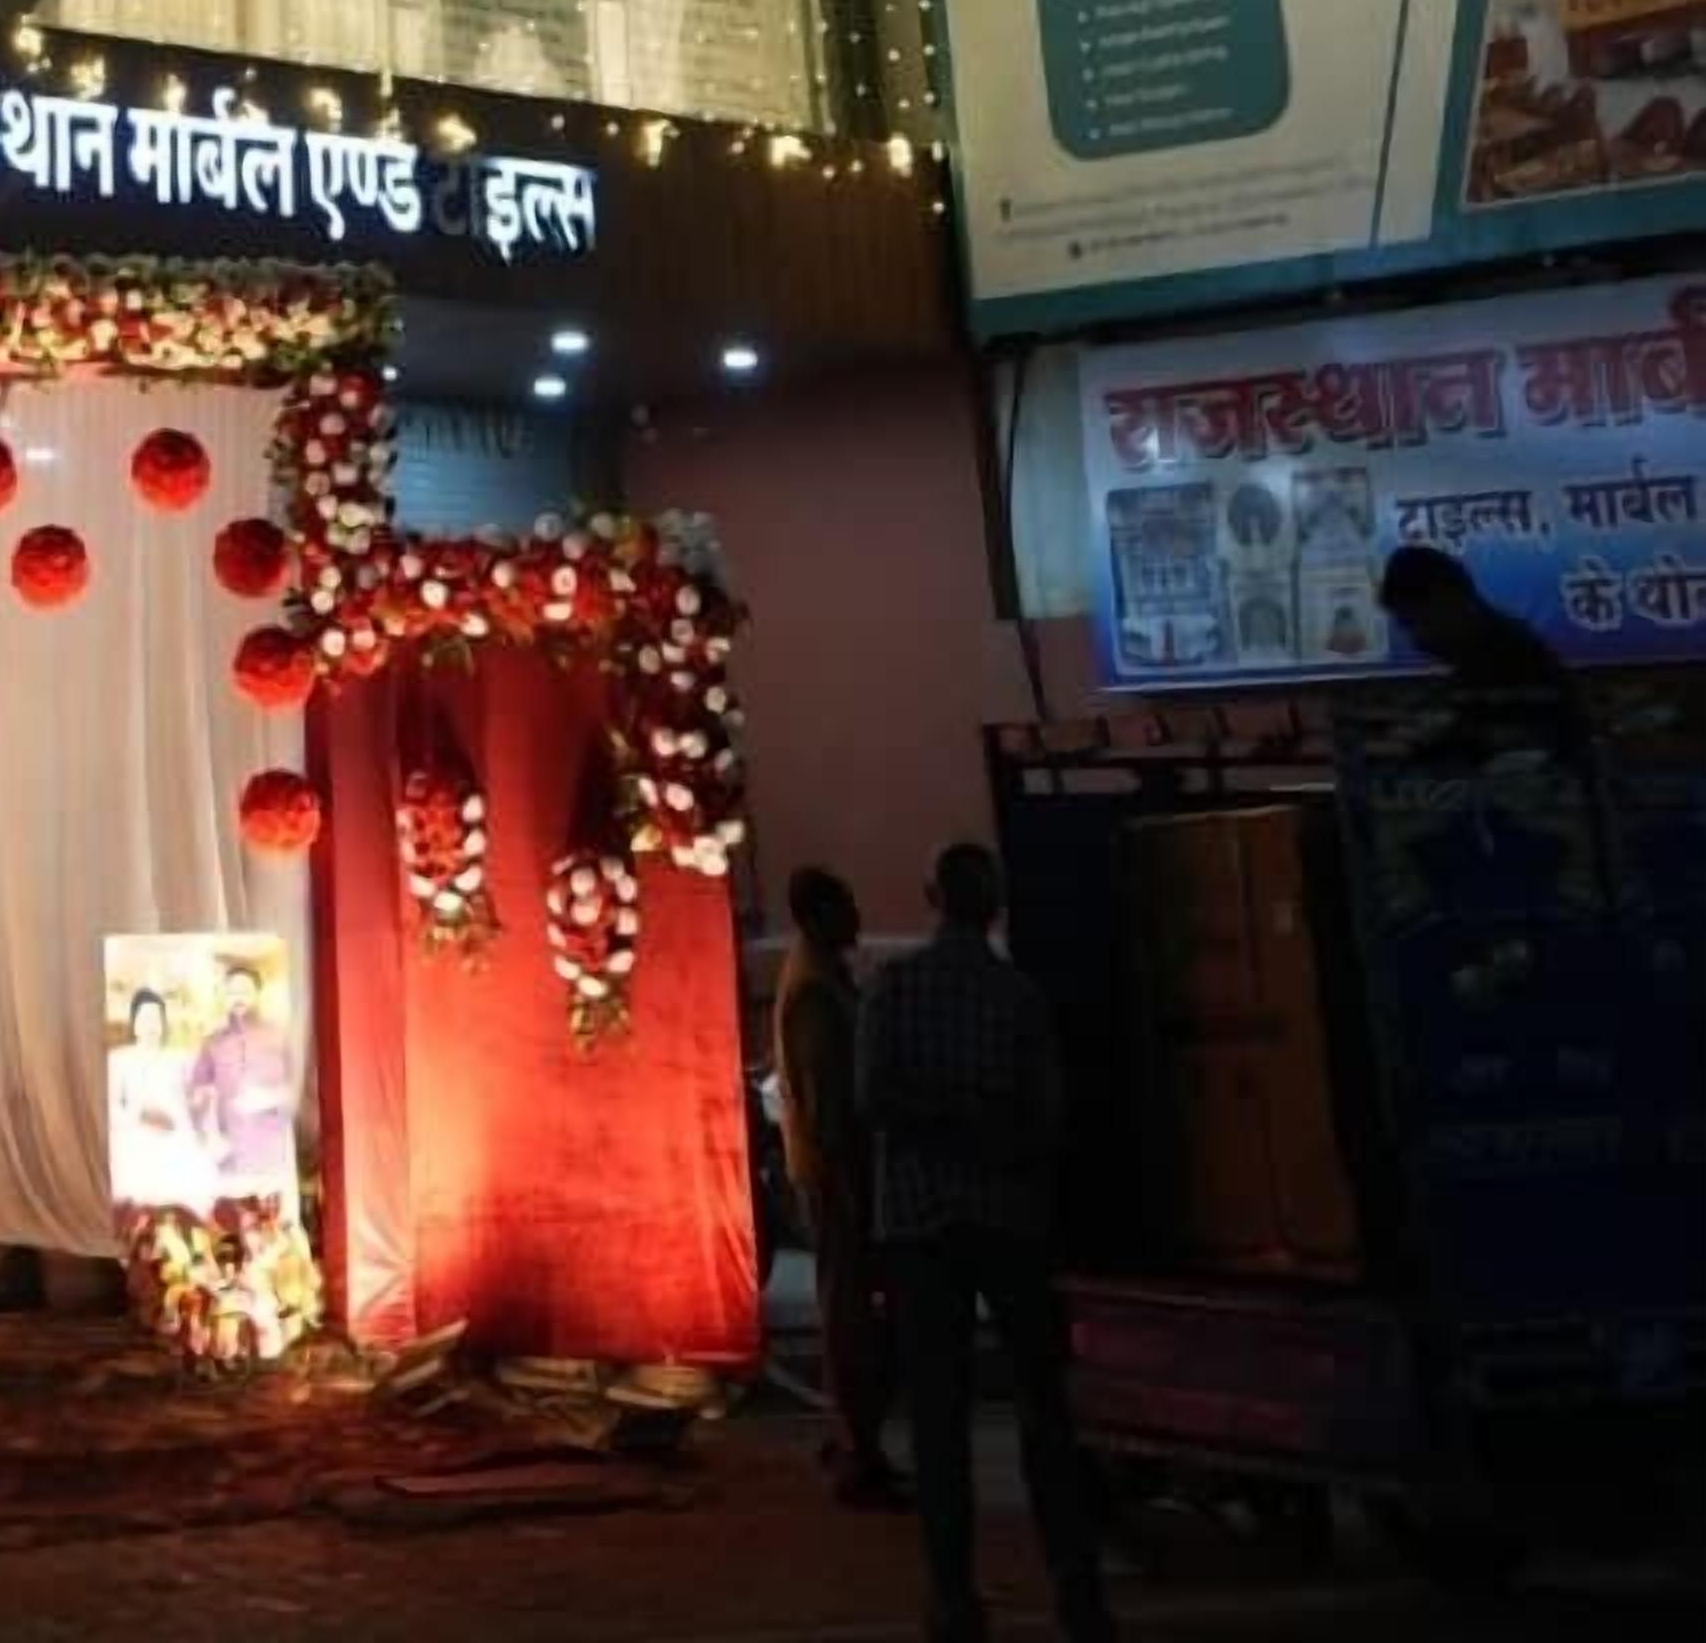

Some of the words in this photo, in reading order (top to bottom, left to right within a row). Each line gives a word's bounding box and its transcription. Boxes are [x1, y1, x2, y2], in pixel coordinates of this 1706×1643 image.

[127, 86, 296, 218] मार्बल
[304, 131, 422, 242] एण्ड
[1105, 351, 1507, 472] राजस्थान
[1563, 455, 1696, 529] मार्बल
[1564, 555, 1624, 629] के
[1634, 553, 1706, 625] थो
